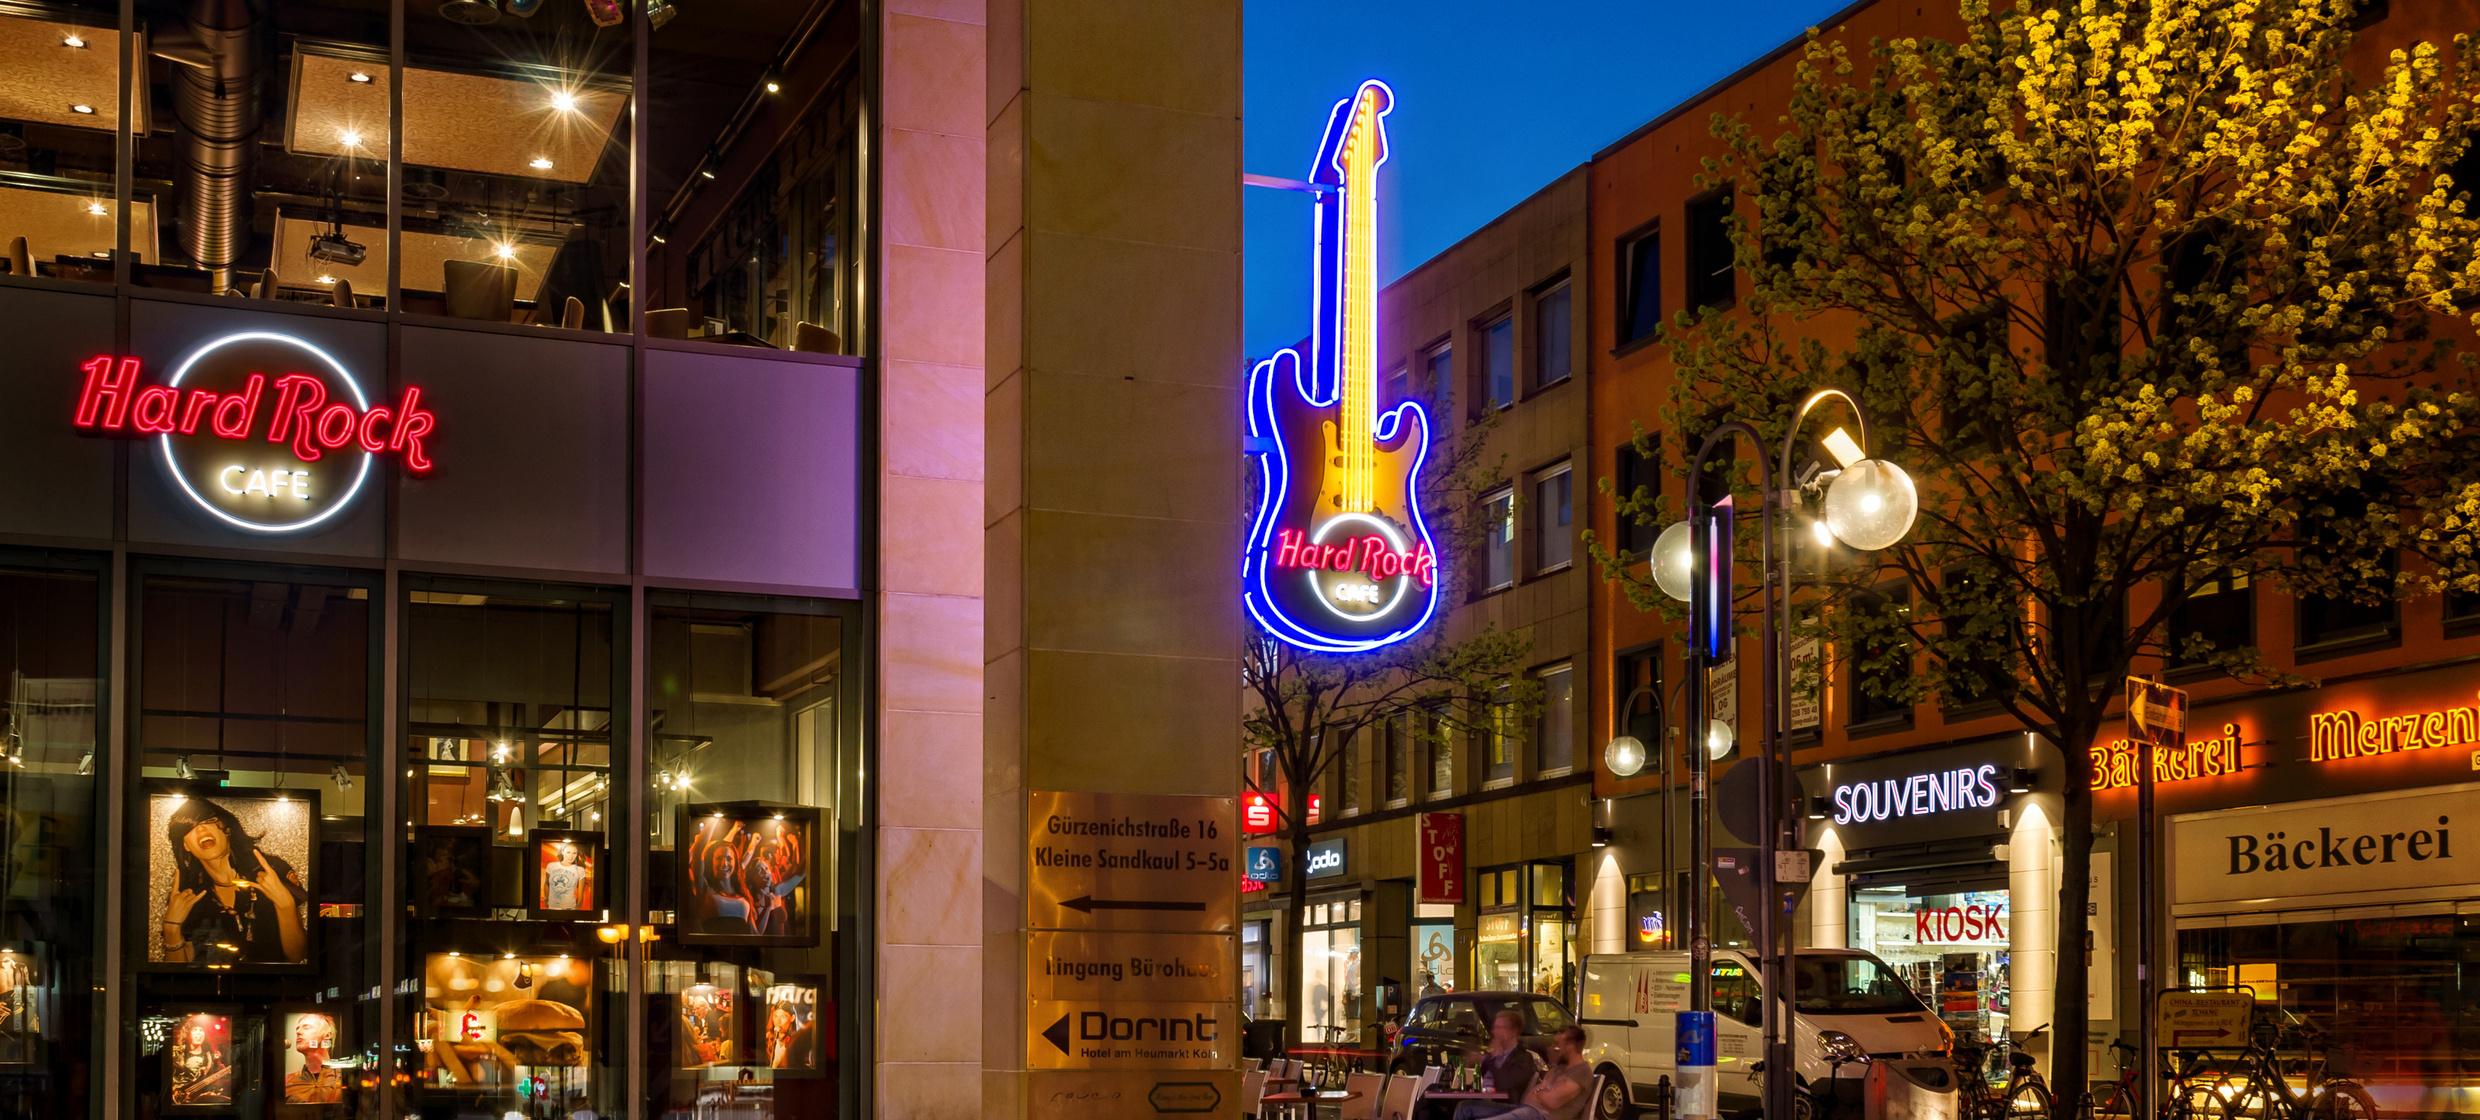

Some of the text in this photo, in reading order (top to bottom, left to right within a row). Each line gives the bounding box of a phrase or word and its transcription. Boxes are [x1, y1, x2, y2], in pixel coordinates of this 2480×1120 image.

[73, 355, 436, 472] Hard Rock
[219, 464, 311, 500] CAFE
[1277, 529, 1433, 586] Hard Rock
[1335, 583, 1380, 604] CAFE
[2311, 690, 2480, 762] Merzen
[1833, 764, 1997, 825] SOUVENIRS
[1047, 815, 1218, 840] Gürzenichstraße 16
[2226, 815, 2453, 876] Bäckerei
[1035, 847, 1092, 868] Kleine
[1098, 850, 1180, 871] Sandkaul
[1915, 903, 2006, 943] KIOSK
[1046, 956, 1123, 981] Eingang
[1080, 1011, 1218, 1040] Dorint
[1081, 1047, 1111, 1059] Hotel
[1114, 1050, 1131, 1059] am
[1135, 1048, 1189, 1060] Heumarkt
